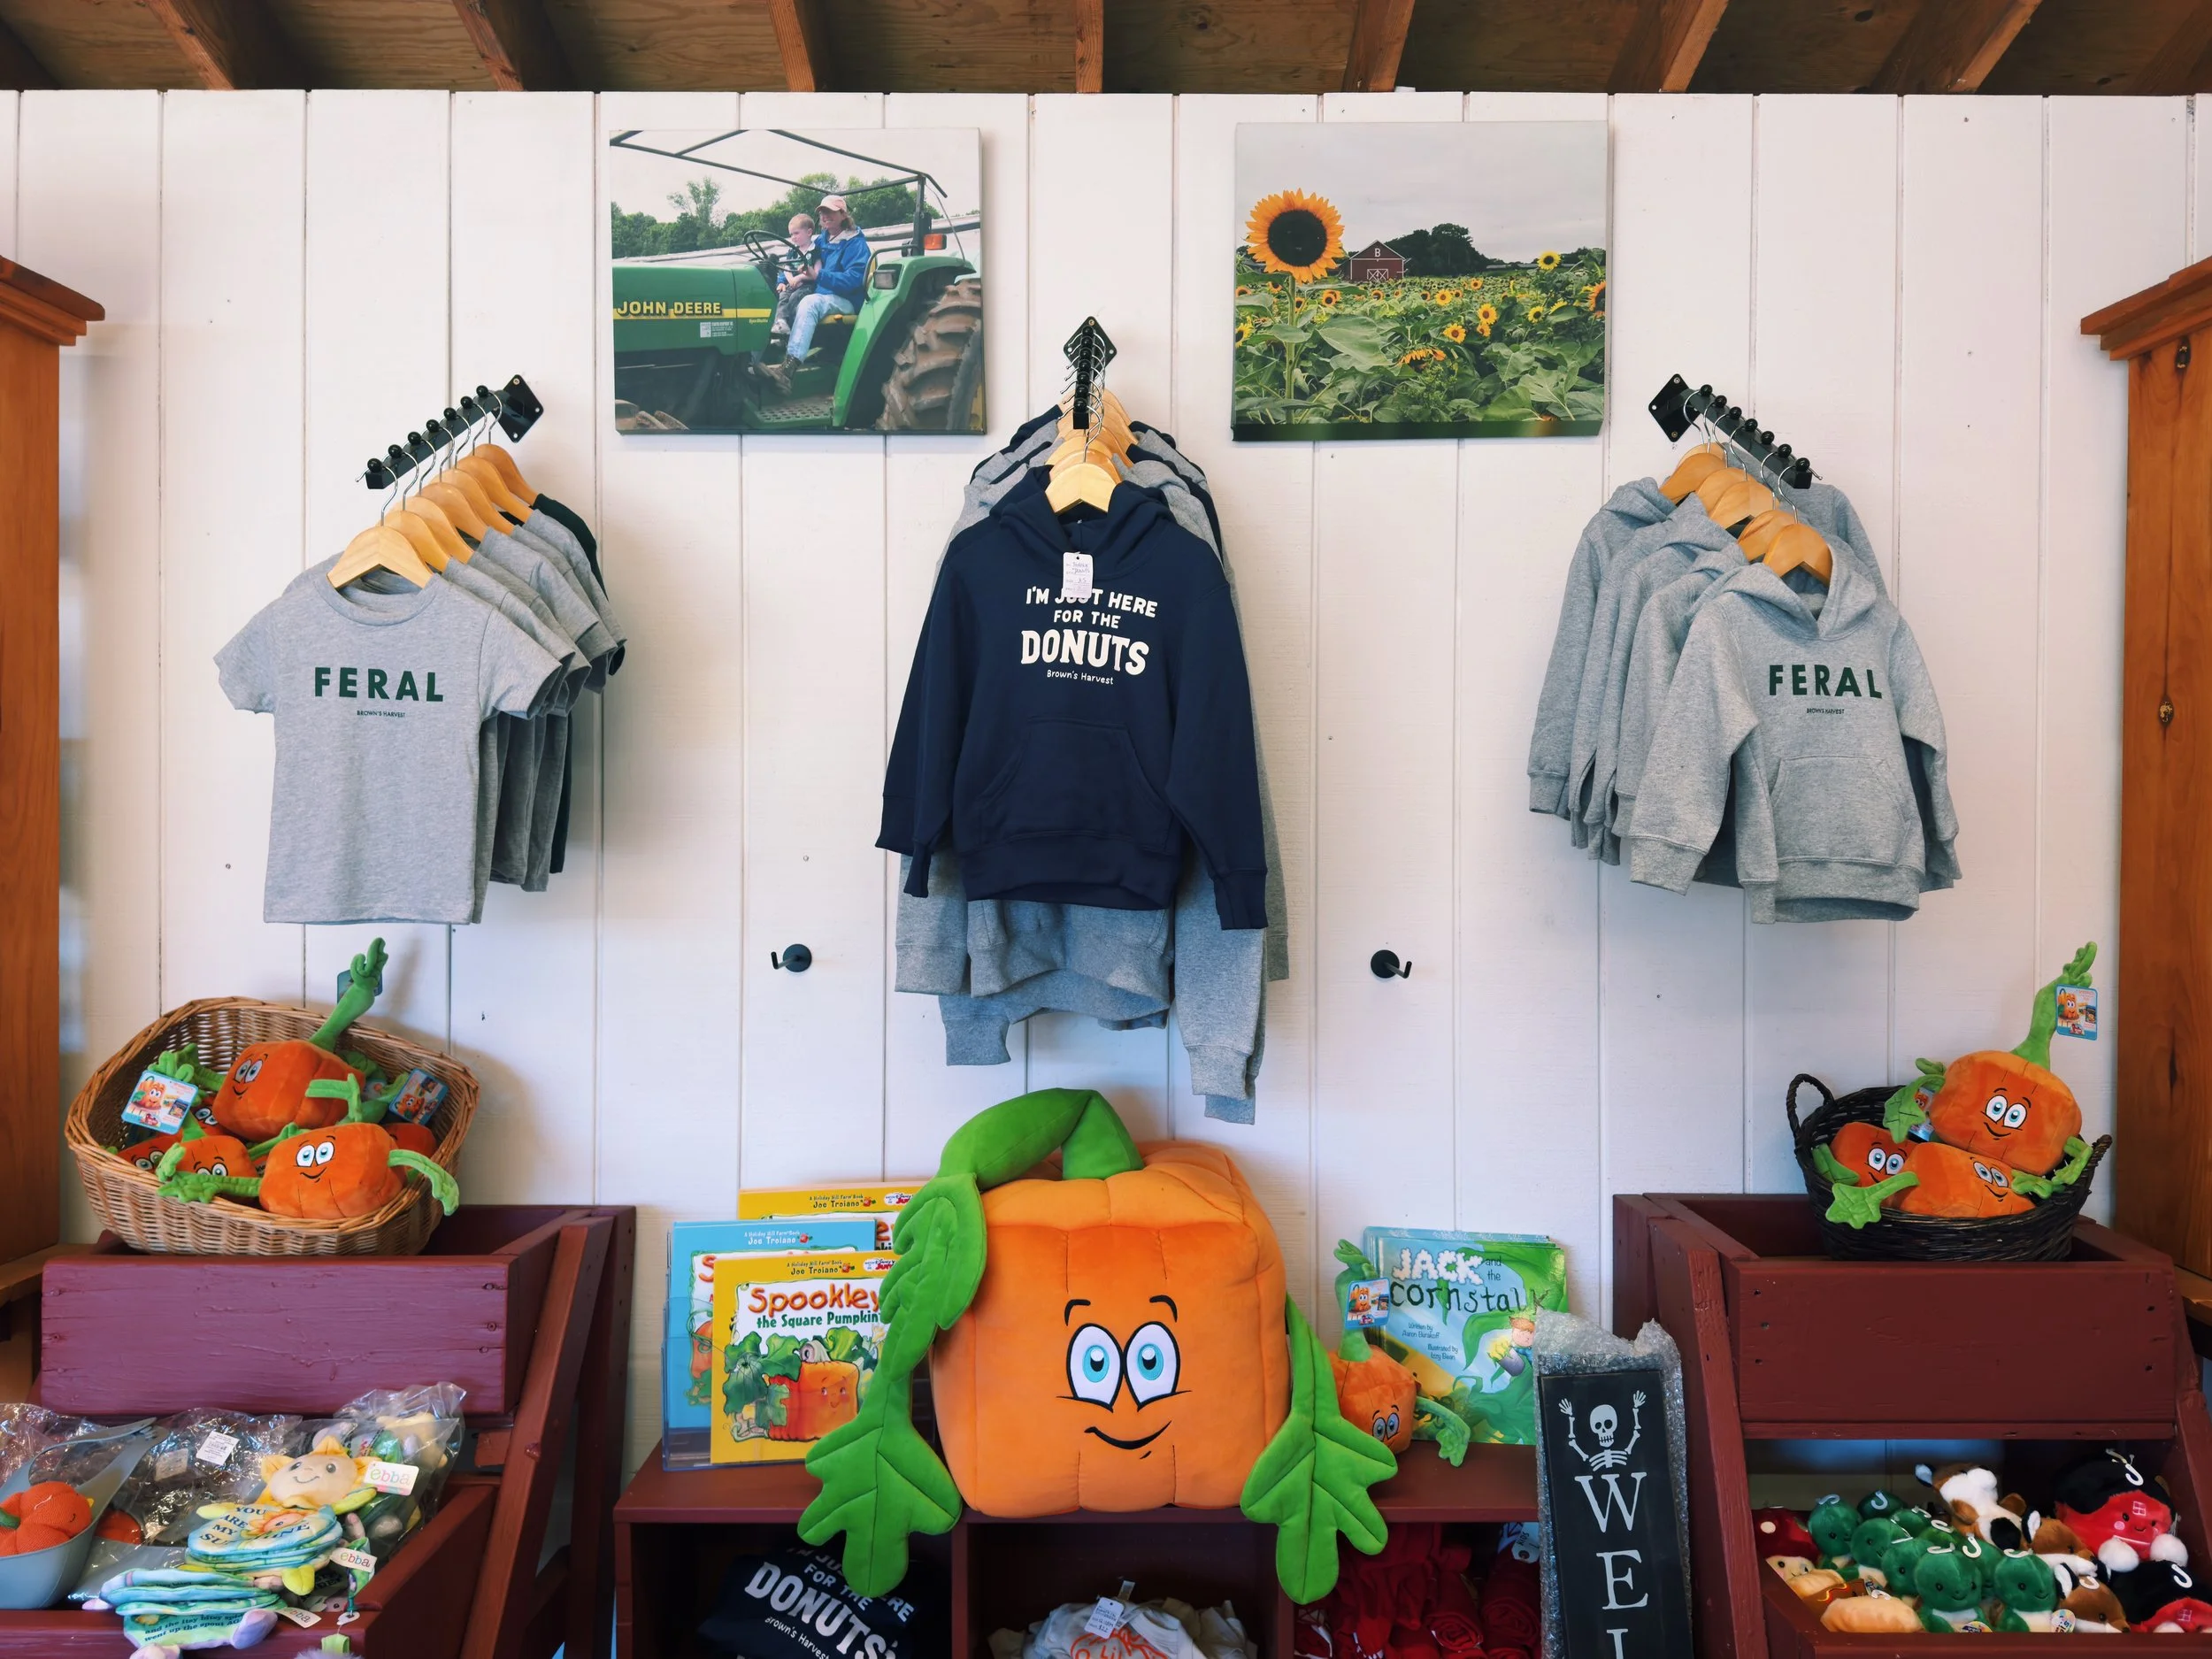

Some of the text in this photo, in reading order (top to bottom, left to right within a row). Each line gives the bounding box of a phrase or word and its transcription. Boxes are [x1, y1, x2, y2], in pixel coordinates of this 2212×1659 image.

[1374, 248, 1381, 257] B
[617, 301, 722, 315] JOHN DEERE
[1025, 586, 1050, 604] I'M
[1108, 591, 1158, 618] HERE
[1053, 610, 1121, 629] FOR THE
[1020, 629, 1149, 676] DONUTS
[314, 666, 443, 703] FERAL
[1047, 669, 1114, 685] Brown's Harvest
[1770, 664, 1882, 699] FERAL
[1392, 1248, 1485, 1286] JACK
[1485, 1256, 1502, 1267] and
[1486, 1270, 1502, 1281] the
[757, 1310, 879, 1328] the Square Pumpkin
[370, 1469, 411, 1486] ebba
[234, 1506, 266, 1516] YOU
[212, 1524, 238, 1536] MY
[220, 1514, 249, 1529] ARE
[340, 1552, 371, 1568] ebba
[803, 1563, 836, 1587] FOR
[744, 1562, 887, 1659] DONUTS
[764, 1616, 797, 1639] Brown's
